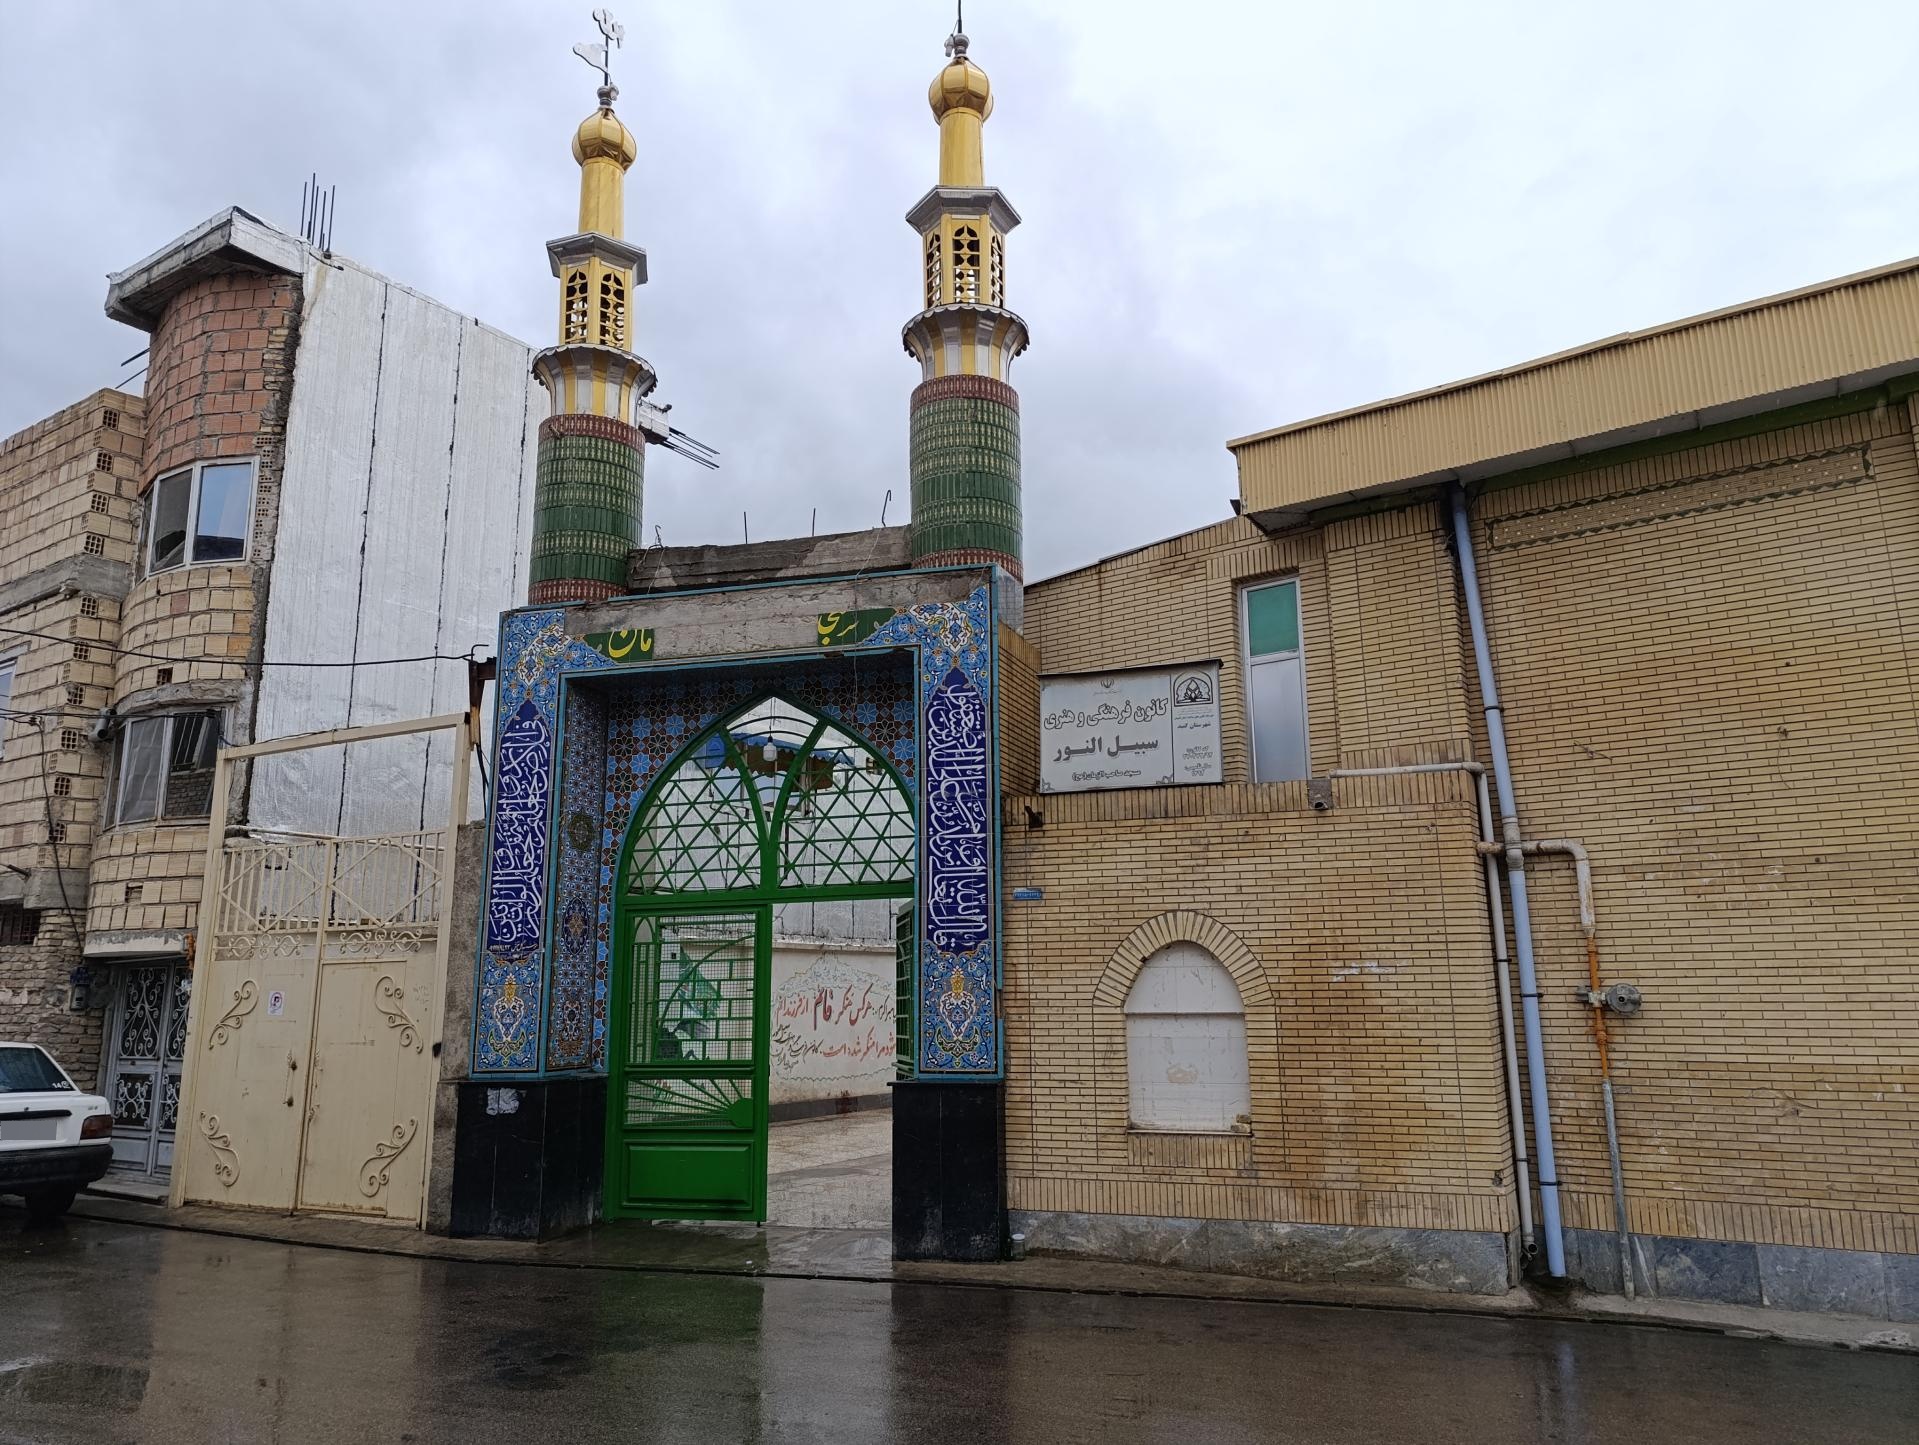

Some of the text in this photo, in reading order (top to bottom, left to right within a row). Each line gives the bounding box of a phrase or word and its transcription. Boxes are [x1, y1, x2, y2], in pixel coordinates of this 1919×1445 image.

[1043, 697, 1169, 730] کانون فرهنگی و هنری
[1053, 735, 1159, 762] سبیل النور
